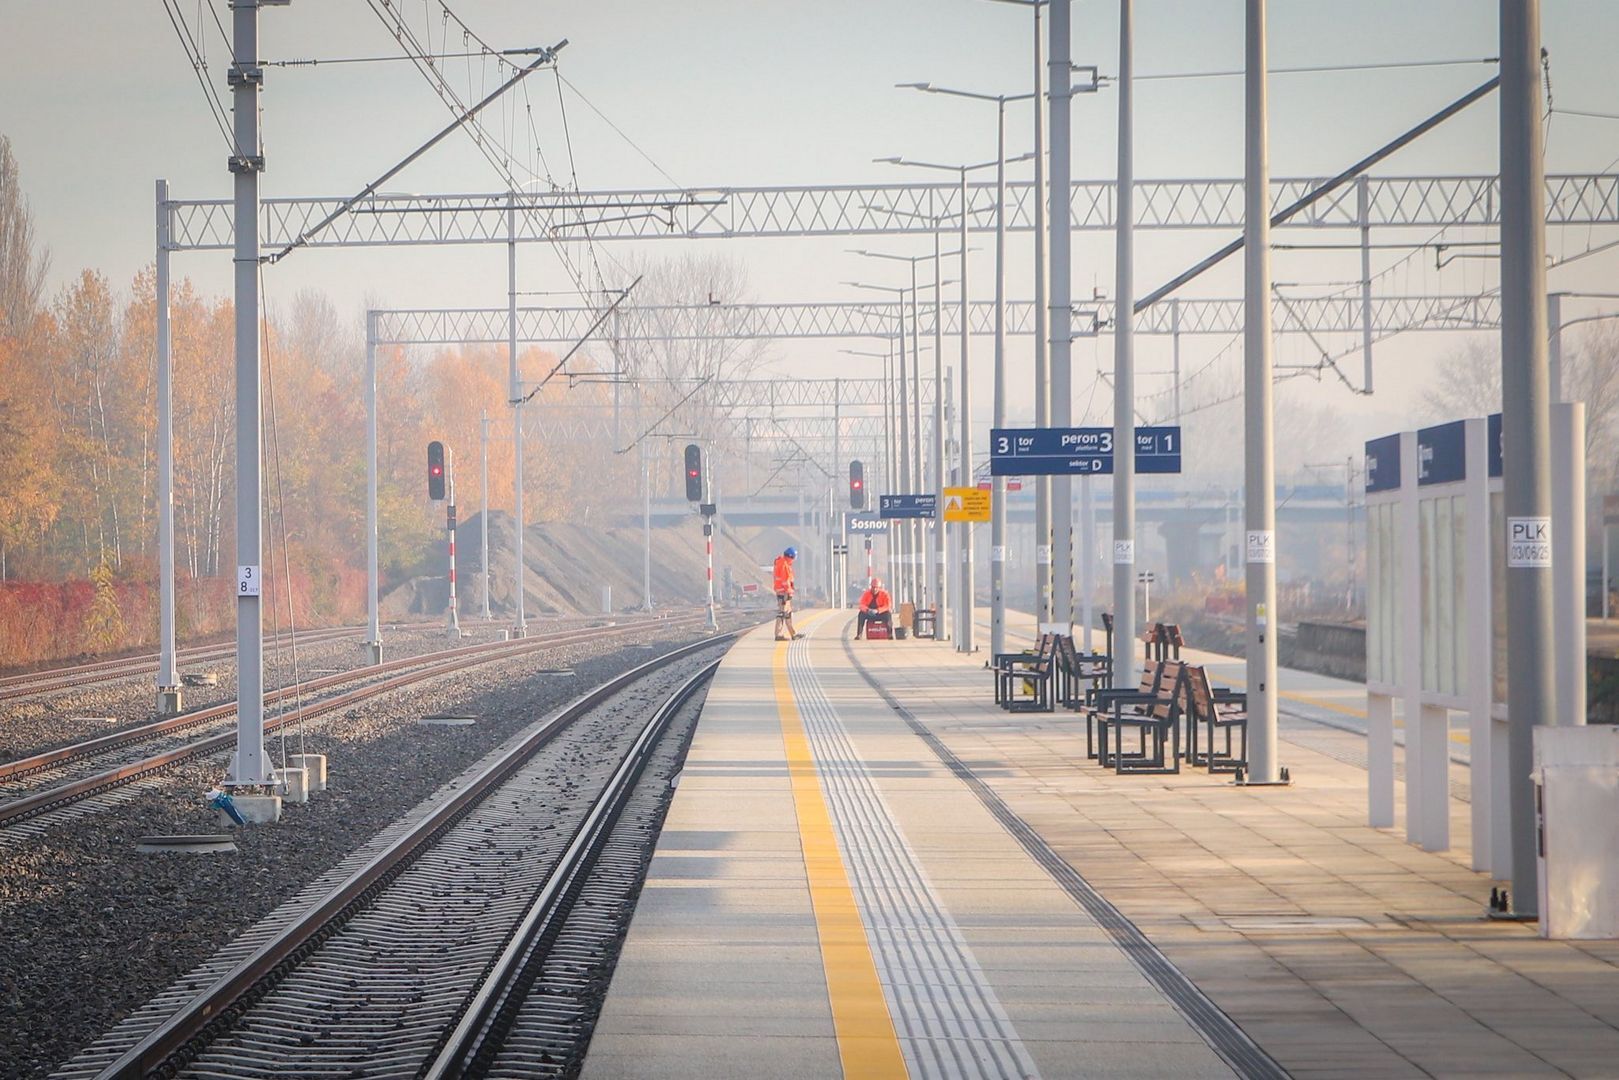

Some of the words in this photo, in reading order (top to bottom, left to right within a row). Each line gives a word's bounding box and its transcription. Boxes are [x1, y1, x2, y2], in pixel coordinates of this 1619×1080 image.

[998, 437, 1009, 454] 3
[1018, 437, 1034, 446] tor
[1061, 434, 1098, 447] peron
[1099, 432, 1113, 452] 3
[1136, 435, 1153, 445] tor
[1164, 434, 1172, 451] 1
[1091, 459, 1102, 471] D
[883, 498, 890, 508] 3
[1513, 524, 1547, 540] PLK
[1249, 535, 1271, 546] PLK
[244, 567, 252, 579] 3
[240, 581, 248, 592] 8
